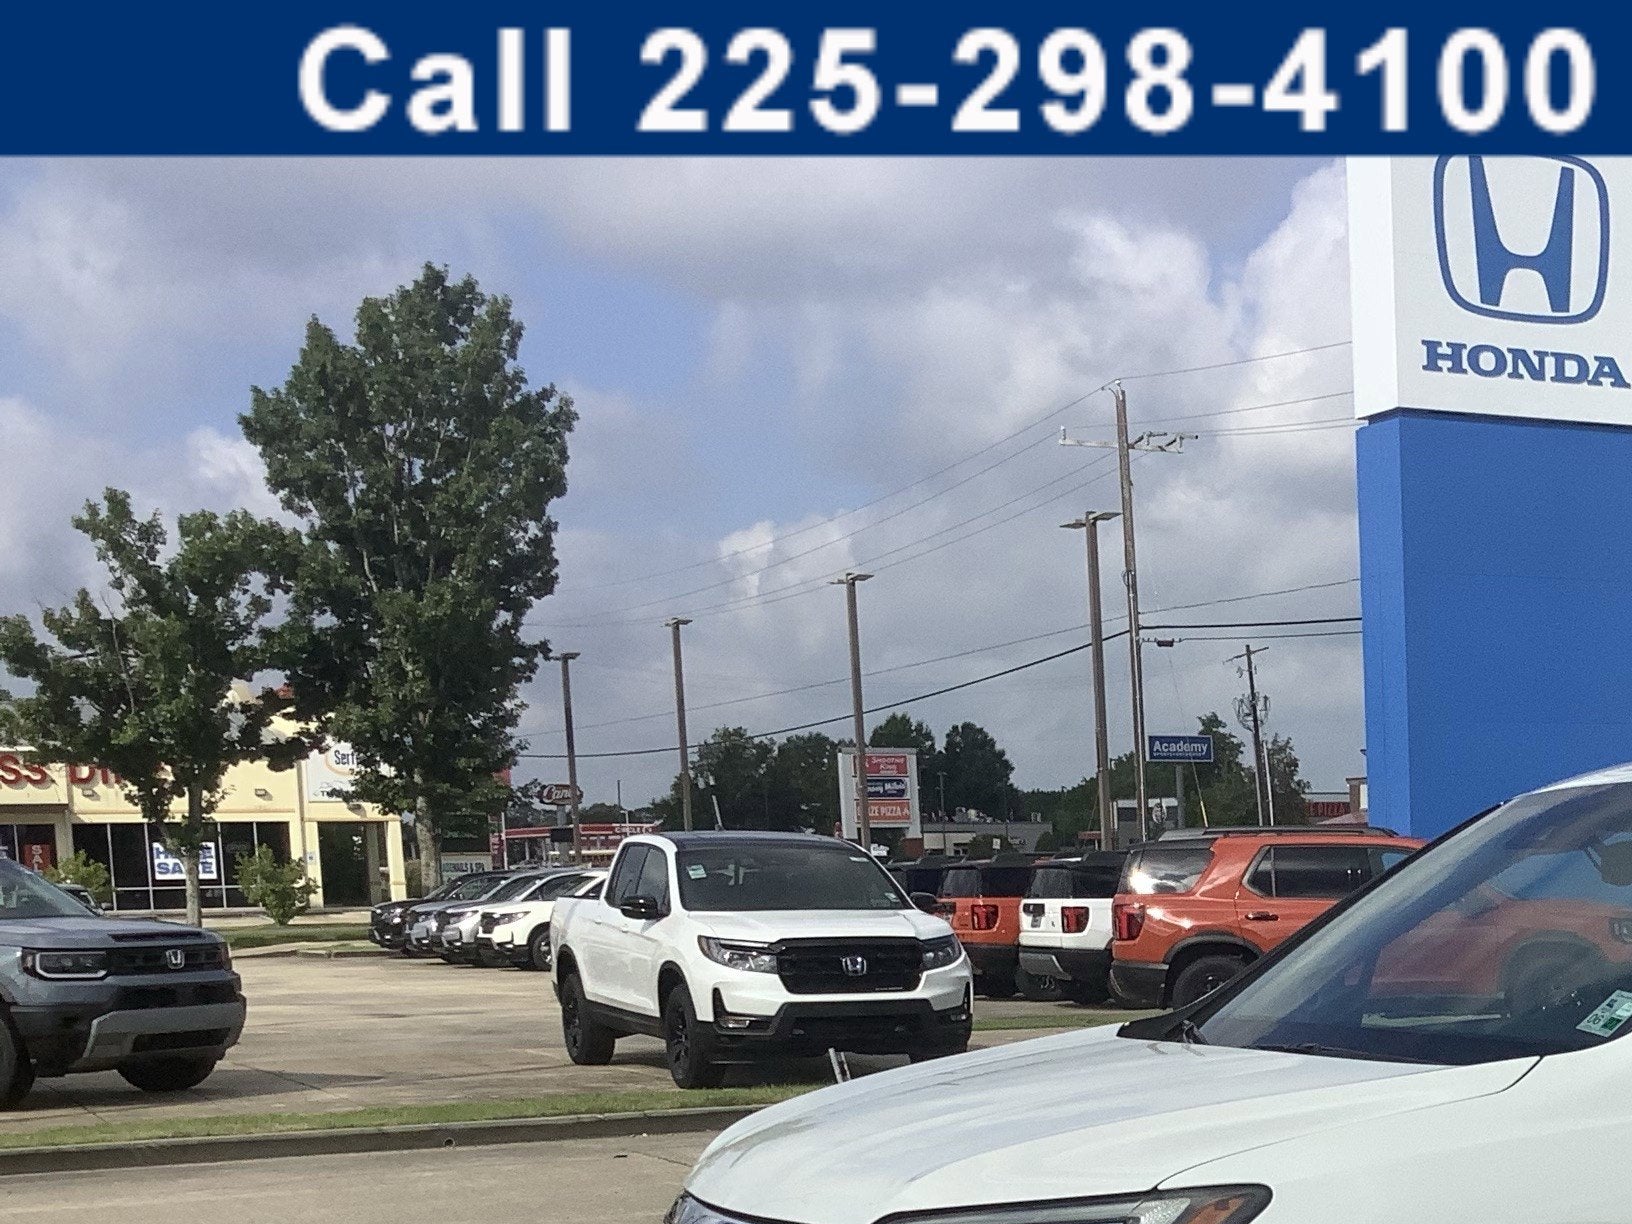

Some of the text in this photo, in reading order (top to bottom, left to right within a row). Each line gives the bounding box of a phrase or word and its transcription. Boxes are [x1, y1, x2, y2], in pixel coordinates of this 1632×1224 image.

[1420, 339, 1632, 390] HONDA
[1153, 740, 1208, 755] Academy
[334, 749, 356, 765] Sert
[881, 806, 901, 817] PIZZA
[157, 862, 214, 875] SAE
